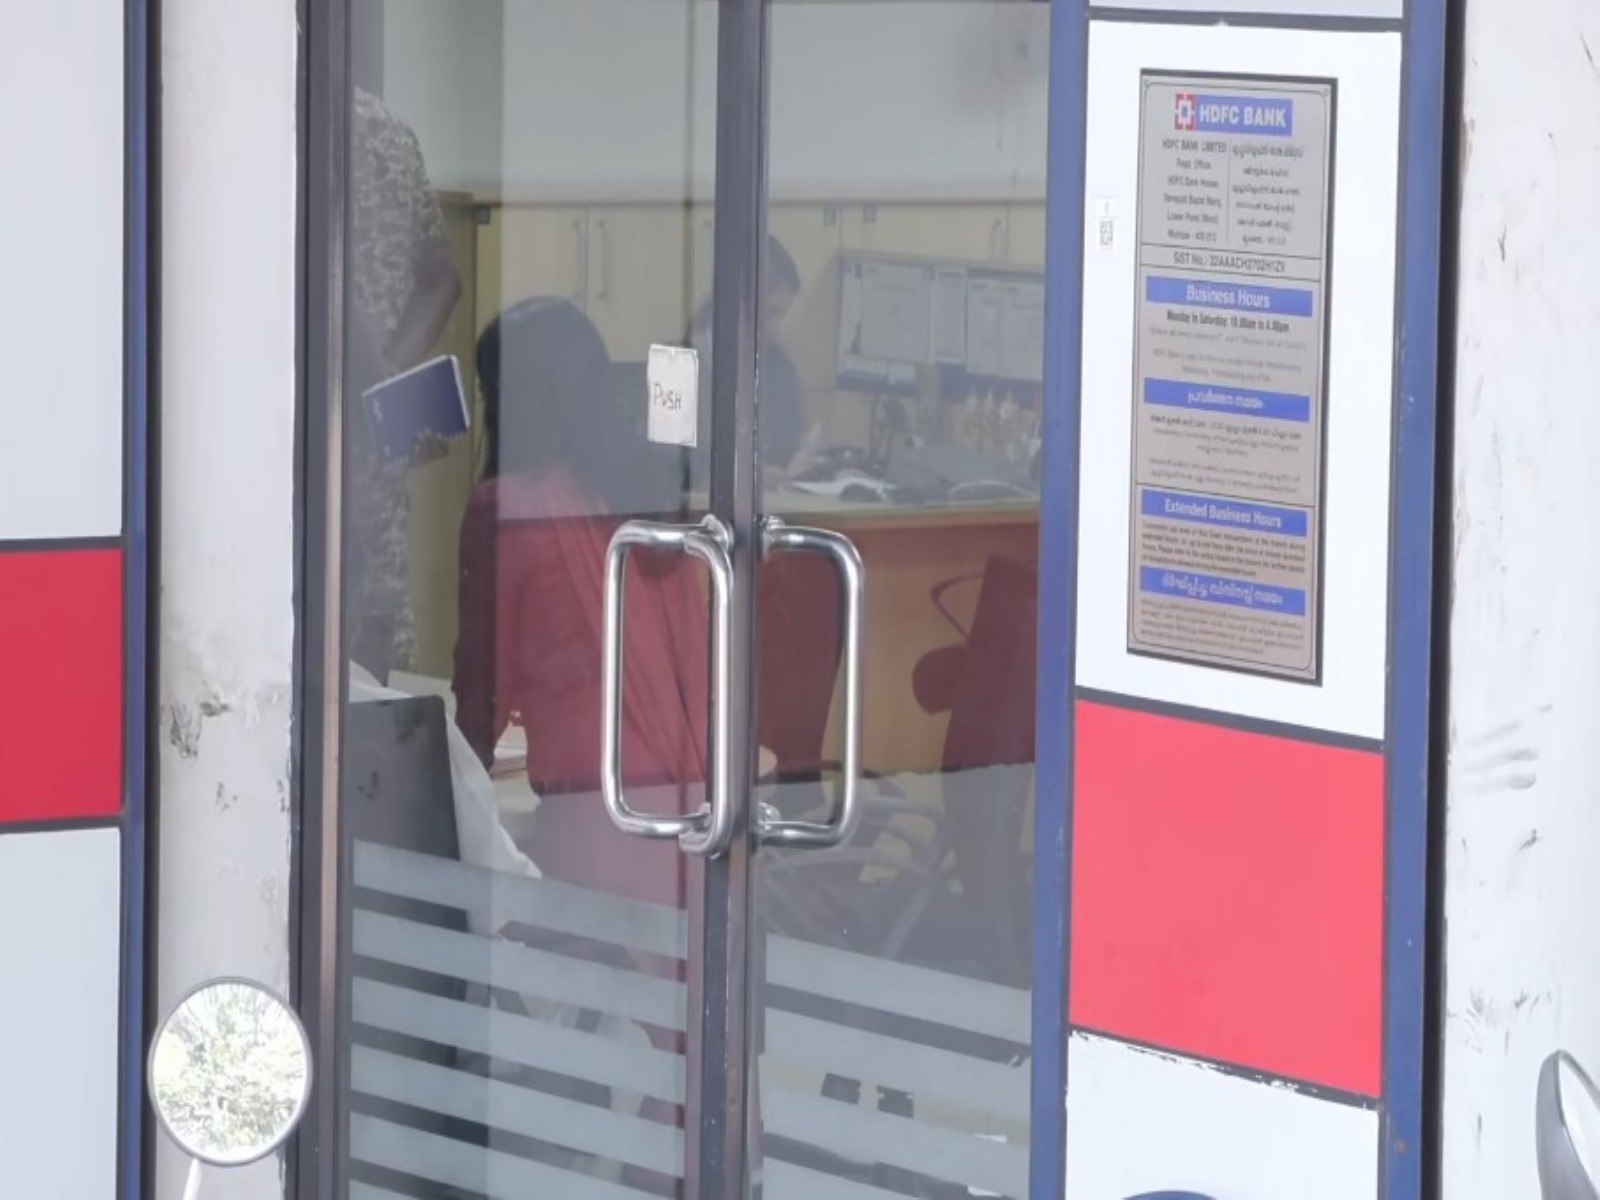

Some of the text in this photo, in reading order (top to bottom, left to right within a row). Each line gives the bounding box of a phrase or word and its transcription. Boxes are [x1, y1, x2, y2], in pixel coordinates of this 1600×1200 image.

[1199, 103, 1287, 127] HDFC BANK
[1181, 139, 1199, 150] BANK
[1173, 251, 1190, 265] GST
[1186, 284, 1271, 308] Business Hours
[1167, 308, 1191, 323] Monday
[1164, 498, 1282, 529] Extended Business Hours
